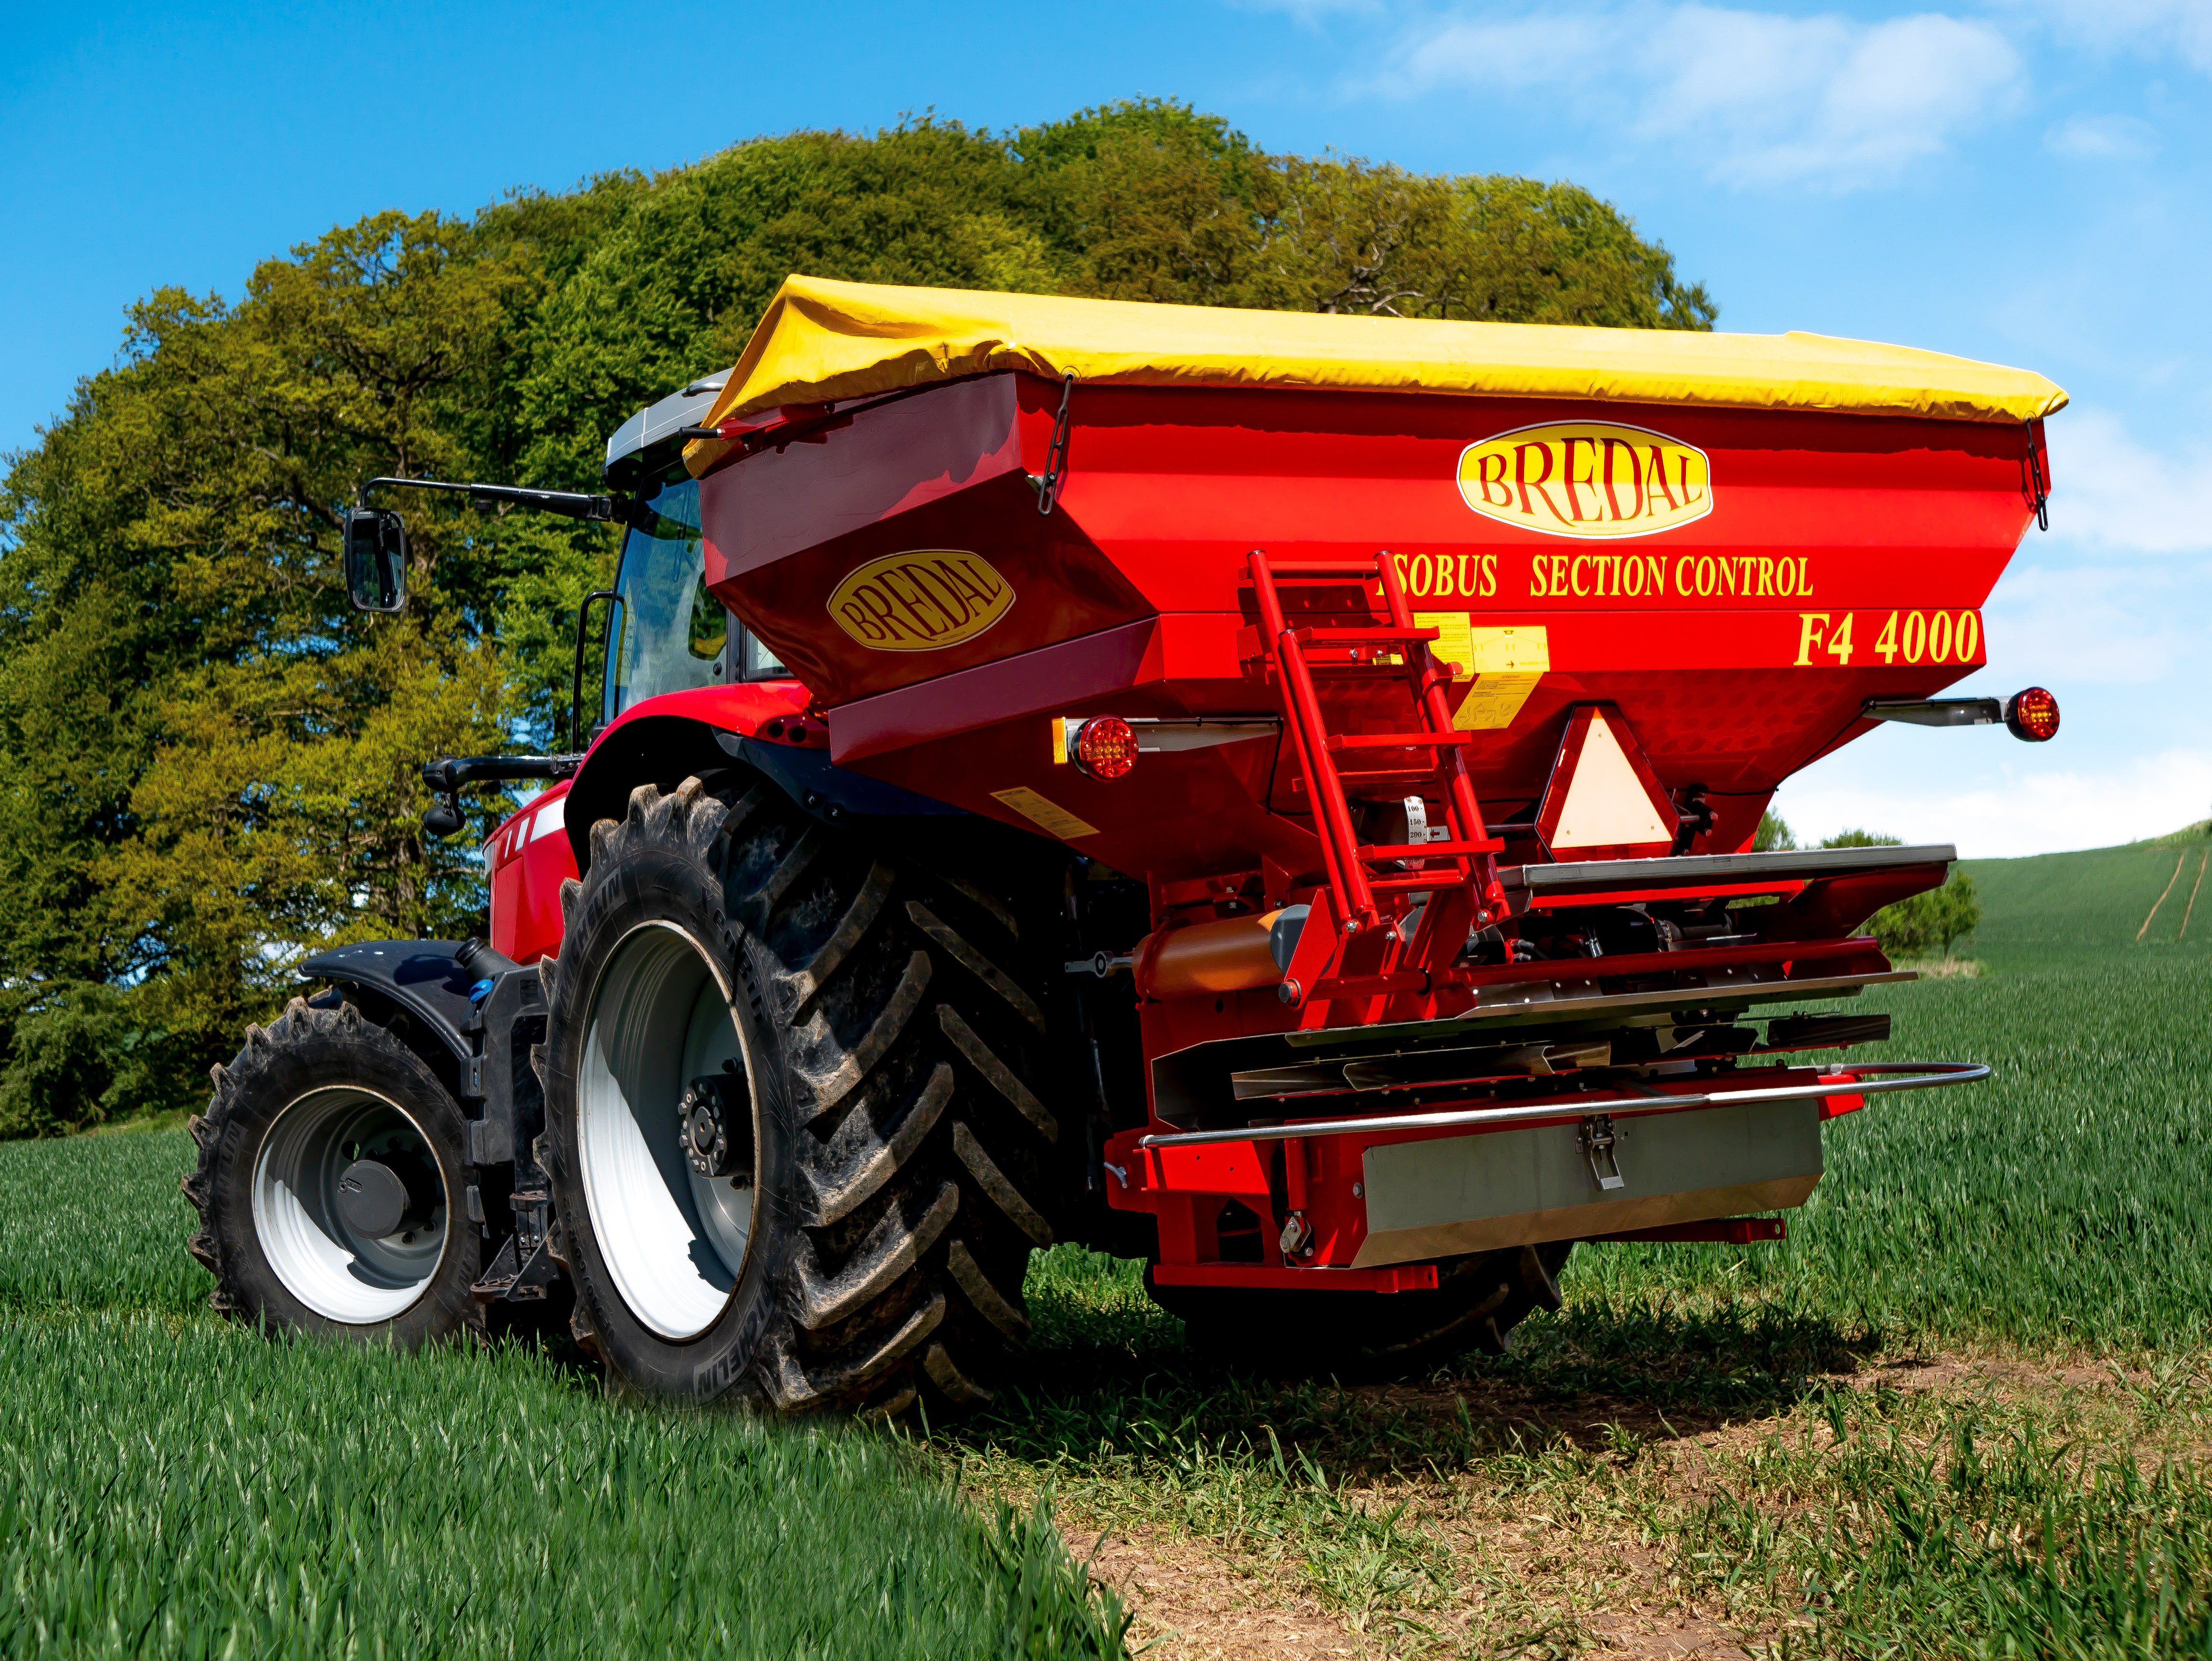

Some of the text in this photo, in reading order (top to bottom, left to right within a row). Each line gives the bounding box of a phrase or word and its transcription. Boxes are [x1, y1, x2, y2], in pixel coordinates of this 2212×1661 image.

[1477, 437, 1702, 527] BREDAL
[840, 560, 1002, 642] BREDAL
[1530, 554, 1669, 597] SECTION
[1675, 555, 1814, 597] CONTROL
[1793, 610, 1978, 666] F4 4000
